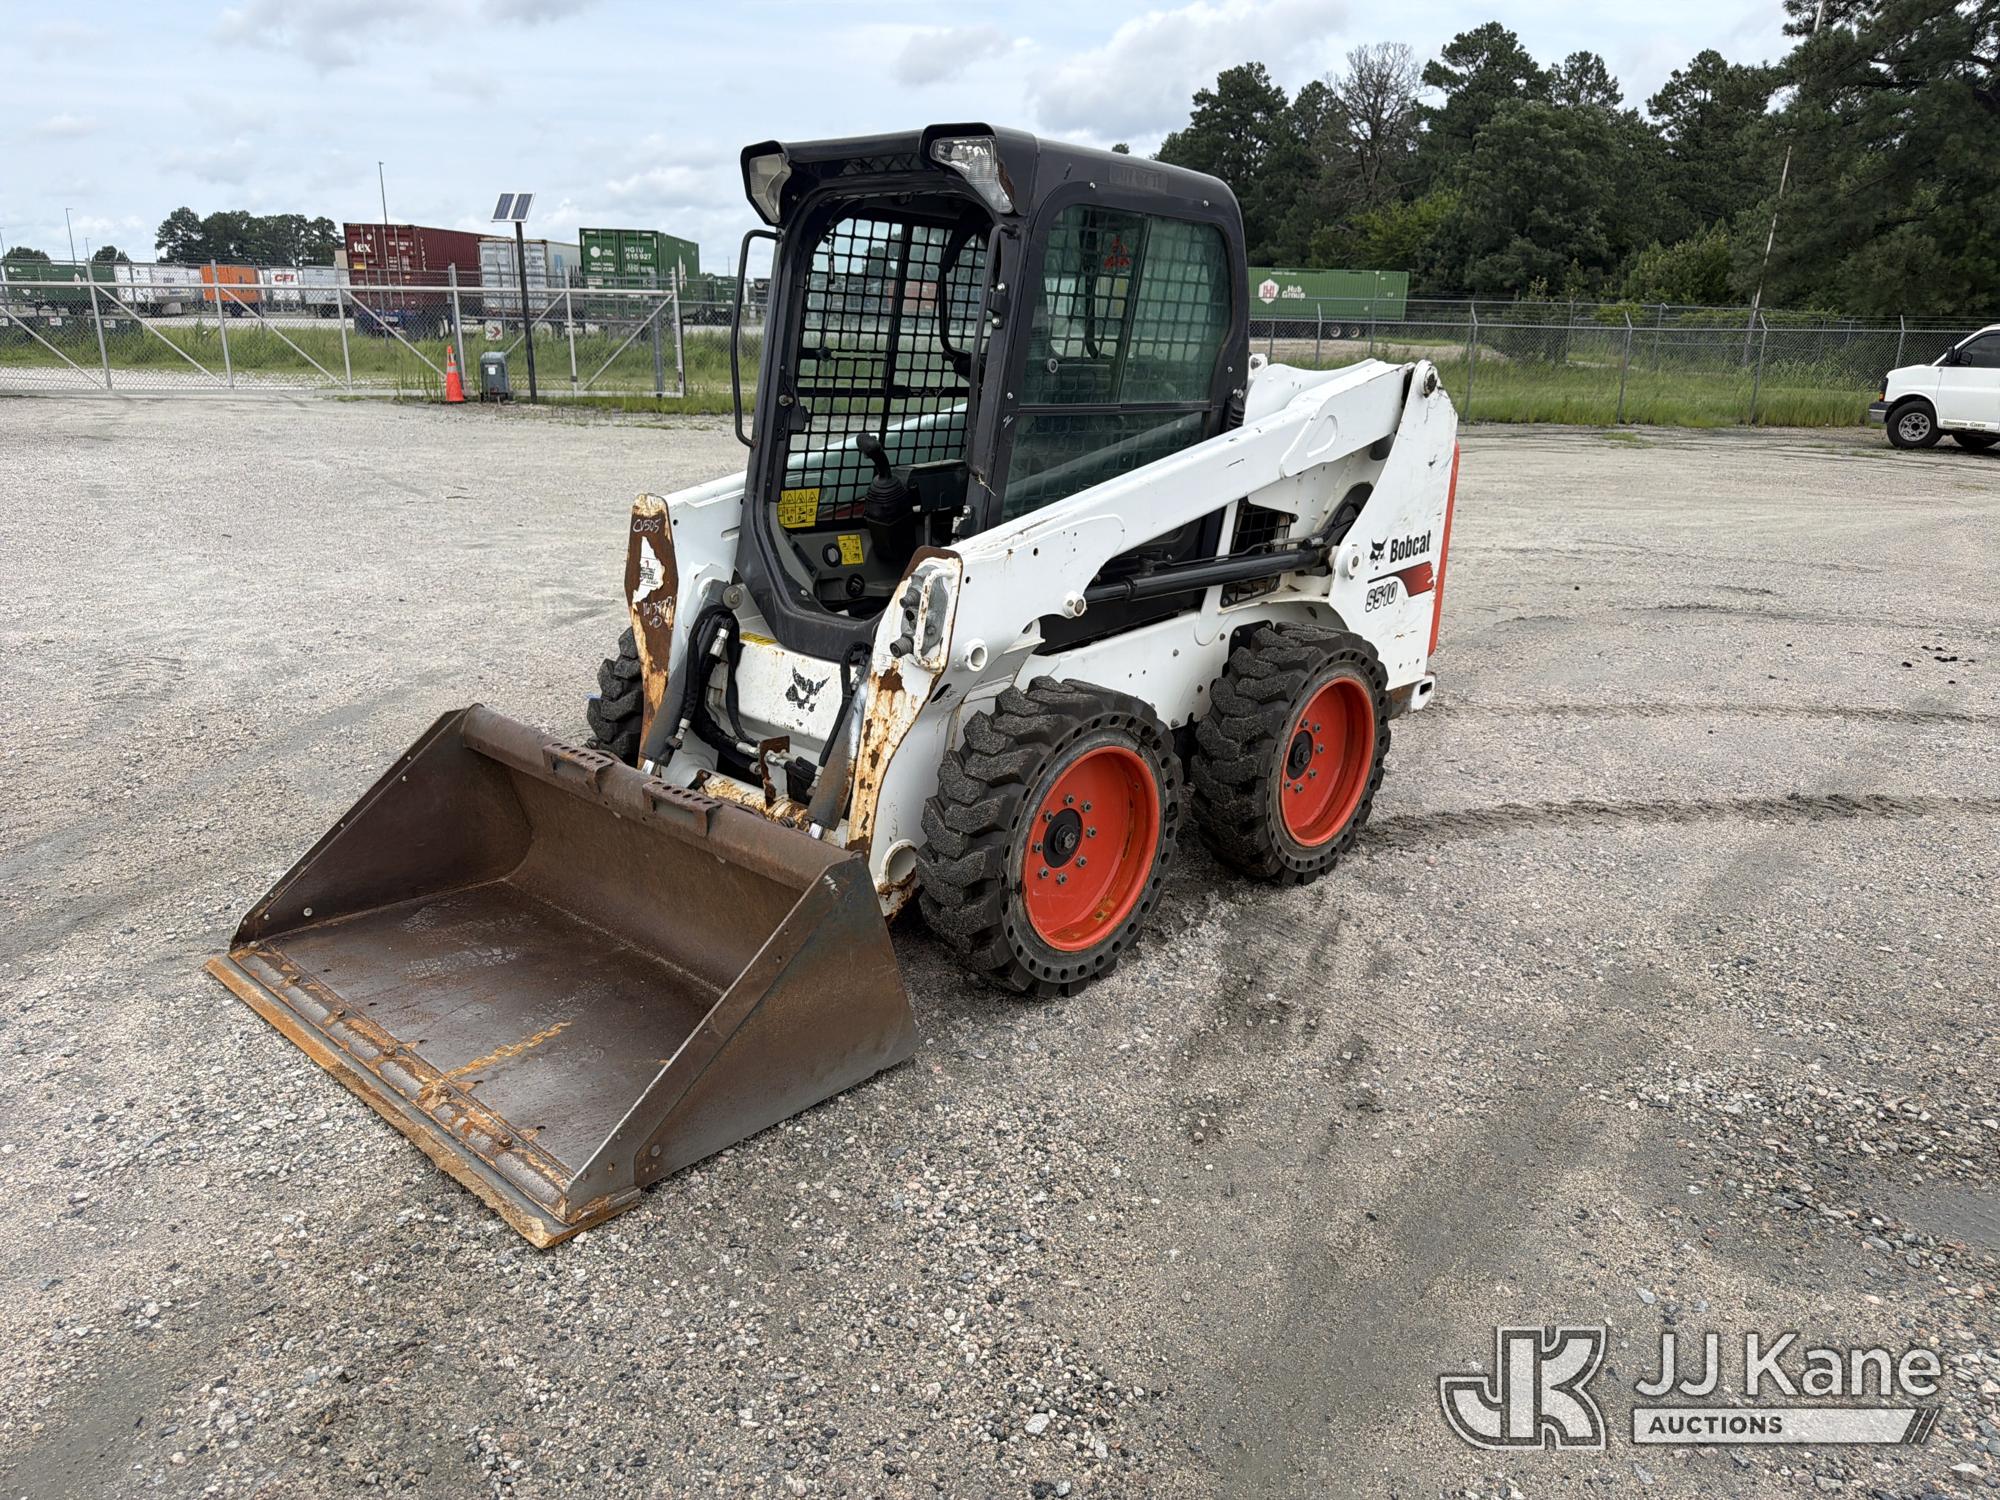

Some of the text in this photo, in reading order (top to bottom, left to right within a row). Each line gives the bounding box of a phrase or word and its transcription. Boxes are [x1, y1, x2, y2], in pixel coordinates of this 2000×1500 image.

[353, 241, 372, 253] tex
[274, 273, 295, 283] CFI
[1287, 284, 1303, 293] Hub
[1281, 290, 1306, 301] Group
[1389, 529, 1432, 564] Bobcat
[1365, 580, 1399, 613] S510
